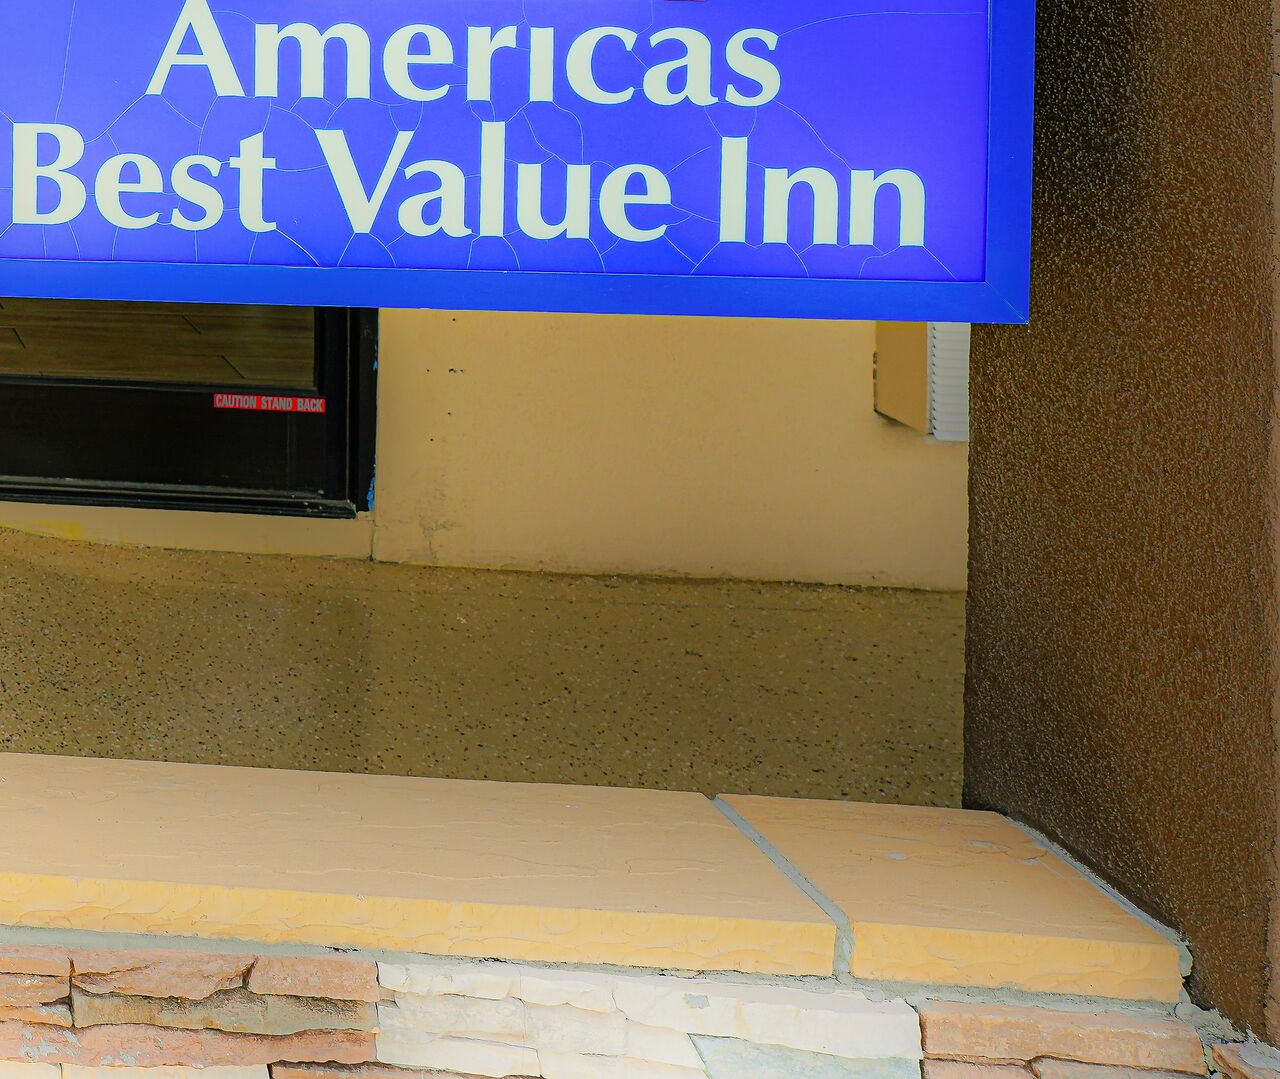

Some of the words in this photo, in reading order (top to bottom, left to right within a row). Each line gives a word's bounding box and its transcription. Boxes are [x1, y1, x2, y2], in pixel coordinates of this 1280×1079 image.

[12, 122, 277, 234] Best
[313, 121, 671, 241] Value
[719, 136, 925, 245] Inn
[215, 394, 256, 409] CAUTION
[260, 396, 293, 410] STAND
[297, 398, 323, 412] BACK
